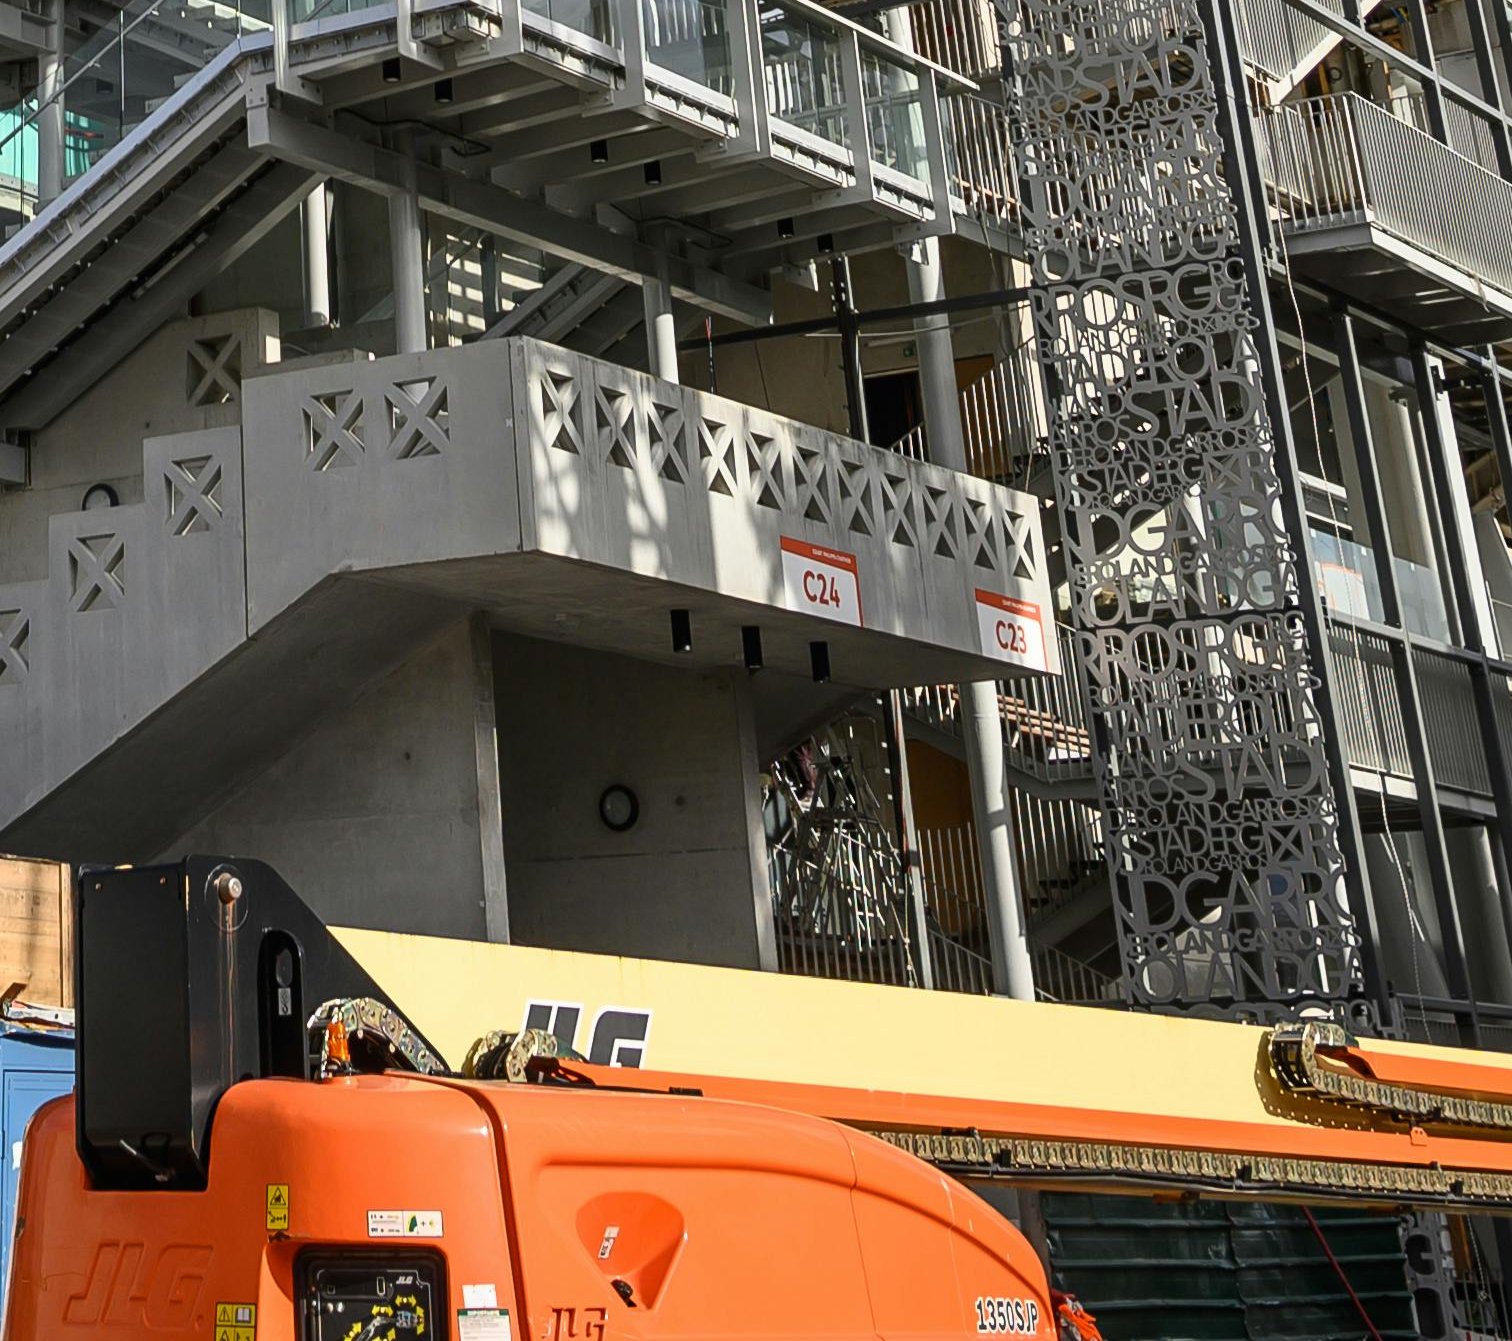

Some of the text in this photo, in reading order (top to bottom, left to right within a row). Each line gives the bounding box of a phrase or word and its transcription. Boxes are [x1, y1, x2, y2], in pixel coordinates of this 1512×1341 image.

[803, 570, 840, 608] C24
[996, 620, 1027, 655] C23
[396, 1276, 413, 1285] JLG
[975, 1297, 1039, 1335] 1350SJP
